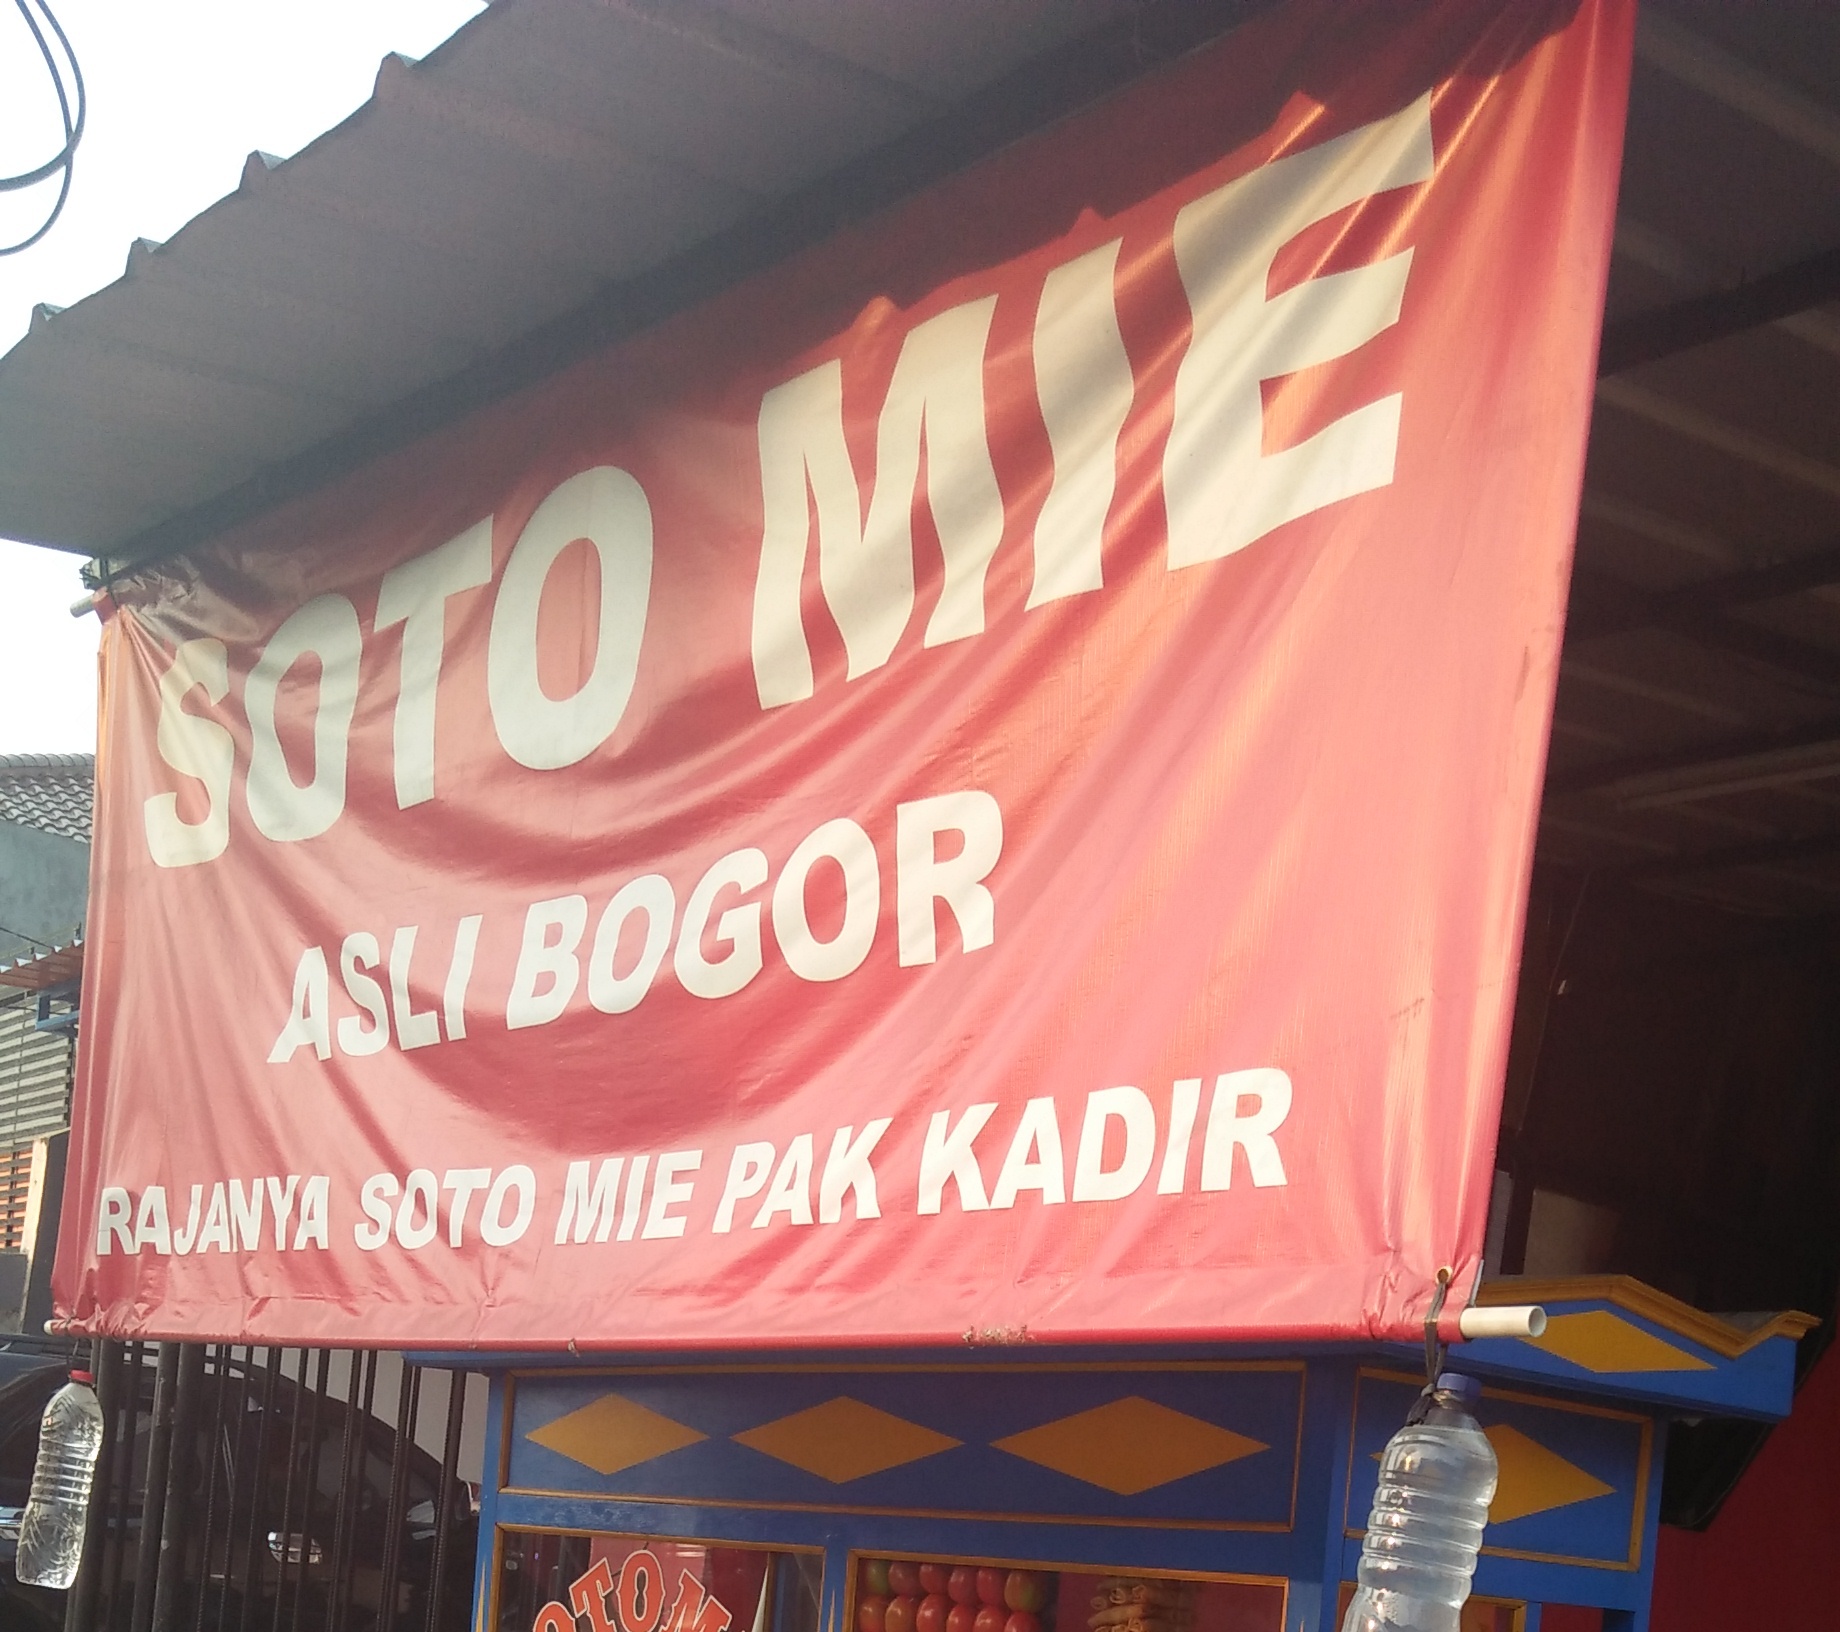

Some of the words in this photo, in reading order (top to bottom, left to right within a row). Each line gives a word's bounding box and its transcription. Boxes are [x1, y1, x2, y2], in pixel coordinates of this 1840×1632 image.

[144, 465, 654, 869] SOTO
[751, 87, 1435, 711] MIE
[266, 914, 484, 1064] ASLI
[506, 789, 1004, 1032] BOGOR
[96, 1174, 330, 1257] RAJANYA
[354, 1163, 538, 1252] SOTO
[554, 1149, 703, 1246] MIE
[711, 1116, 894, 1234] PAK
[916, 1066, 1294, 1216] KADIR
